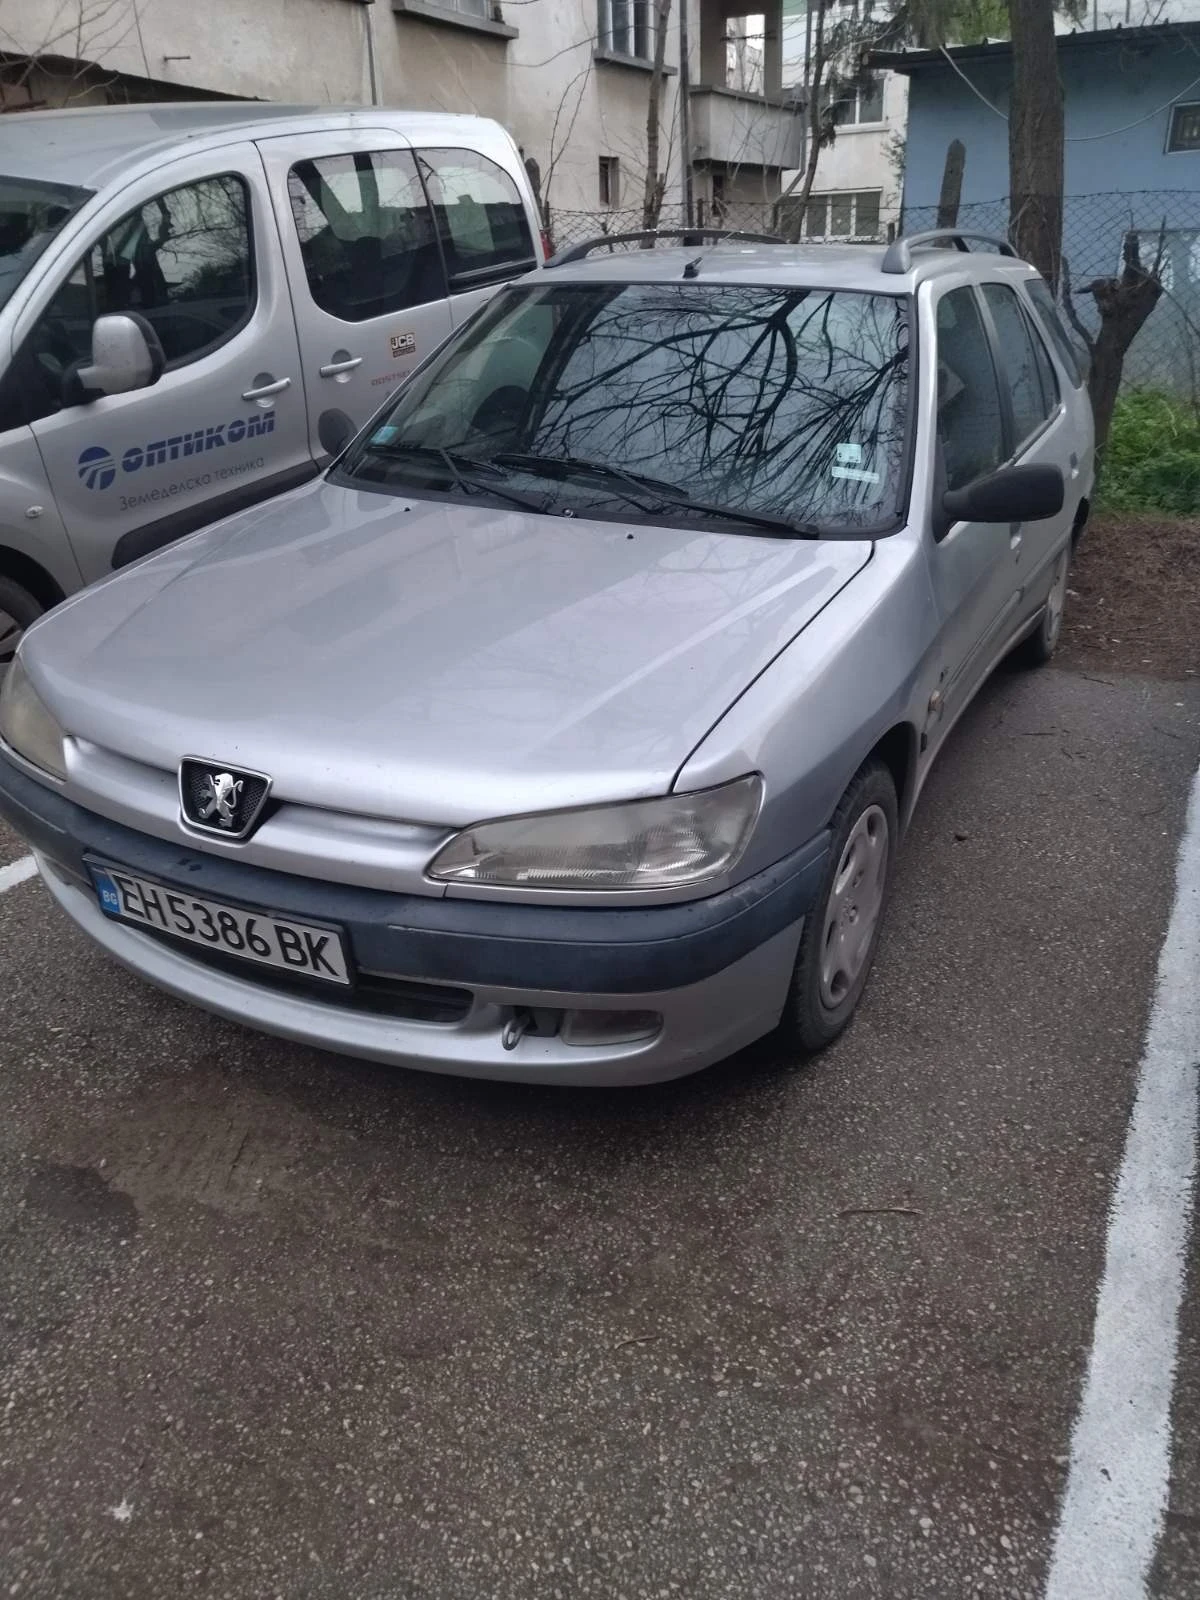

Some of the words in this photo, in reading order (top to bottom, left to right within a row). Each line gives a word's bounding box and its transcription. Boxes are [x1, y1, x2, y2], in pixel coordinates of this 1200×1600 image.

[391, 333, 415, 349] JCB
[121, 411, 276, 473] ОПТИКОМ
[214, 456, 265, 481] техника
[102, 888, 118, 906] BG
